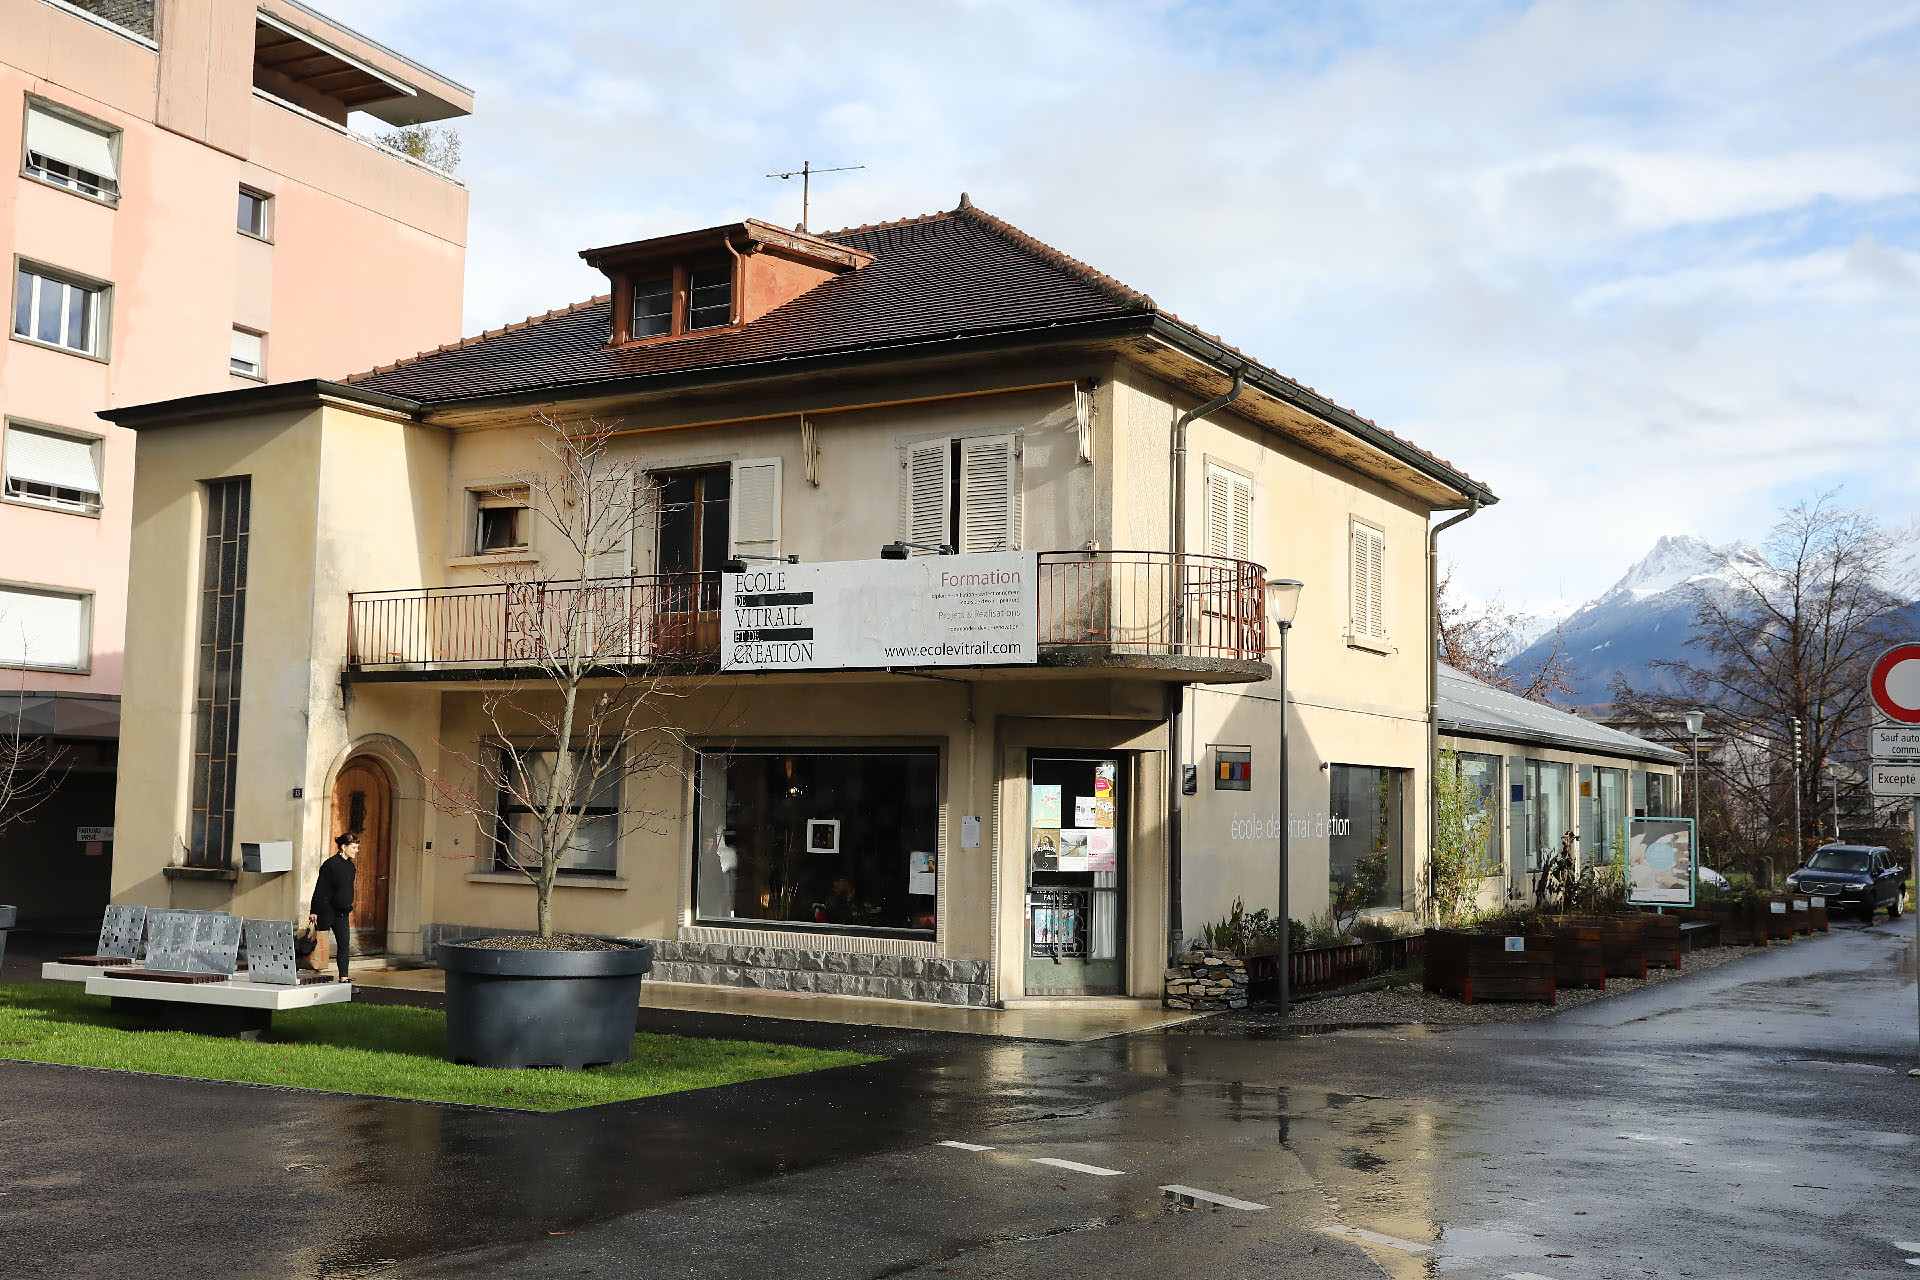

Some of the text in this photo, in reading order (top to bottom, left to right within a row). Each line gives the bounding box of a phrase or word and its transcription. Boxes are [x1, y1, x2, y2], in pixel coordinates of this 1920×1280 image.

[735, 572, 786, 593] ECOLE
[941, 569, 1021, 587] Formation
[735, 595, 747, 606] DE
[735, 607, 803, 628] VITRAIL
[734, 630, 760, 642] ET DE
[884, 641, 1021, 658] www.ecolevitrail.com
[1880, 732, 1899, 742] Sauf
[1878, 773, 1916, 787] Excepté
[1231, 810, 1263, 840] école
[1266, 812, 1280, 839] de
